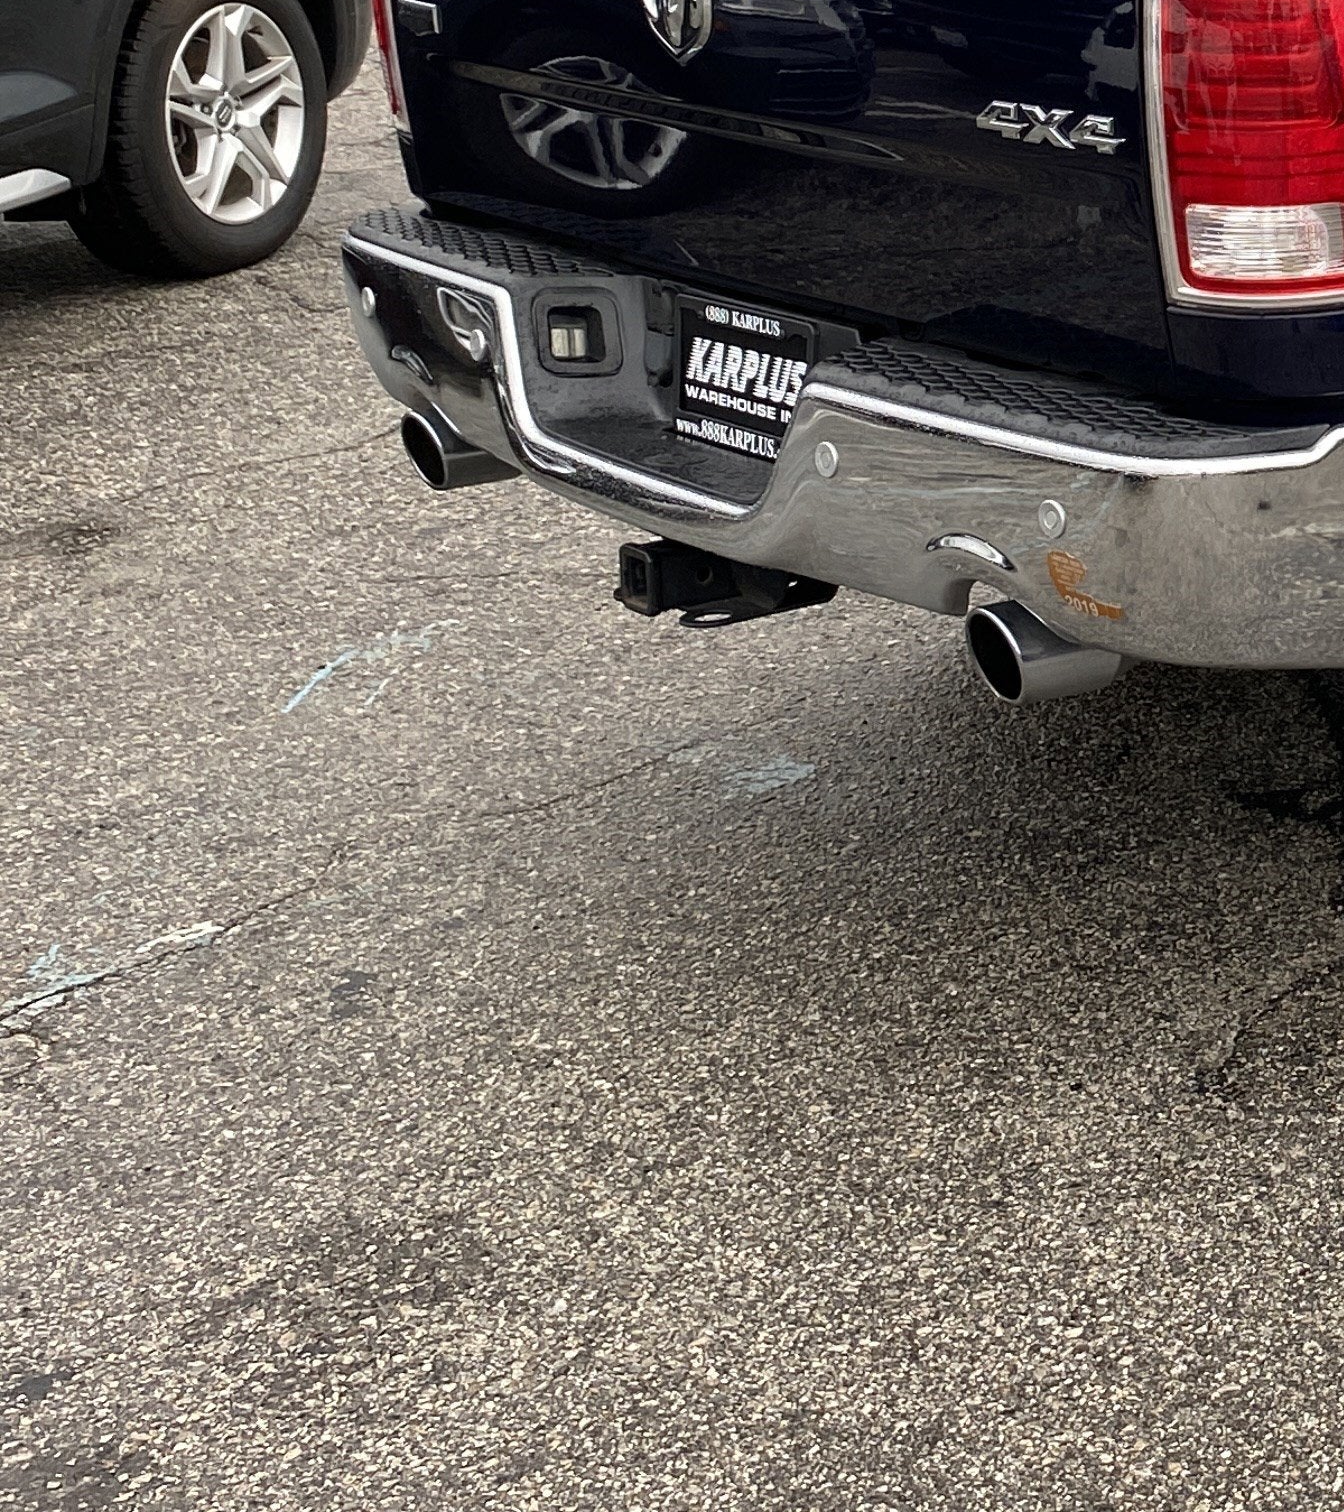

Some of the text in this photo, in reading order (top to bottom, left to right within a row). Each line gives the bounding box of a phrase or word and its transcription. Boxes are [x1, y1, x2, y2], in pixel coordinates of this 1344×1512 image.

[704, 304, 781, 337] (888) KARPLUS
[685, 336, 808, 407] KARPLUS
[684, 383, 776, 421] WAREHOUSE
[675, 417, 781, 459] www.888KARPLUS.
